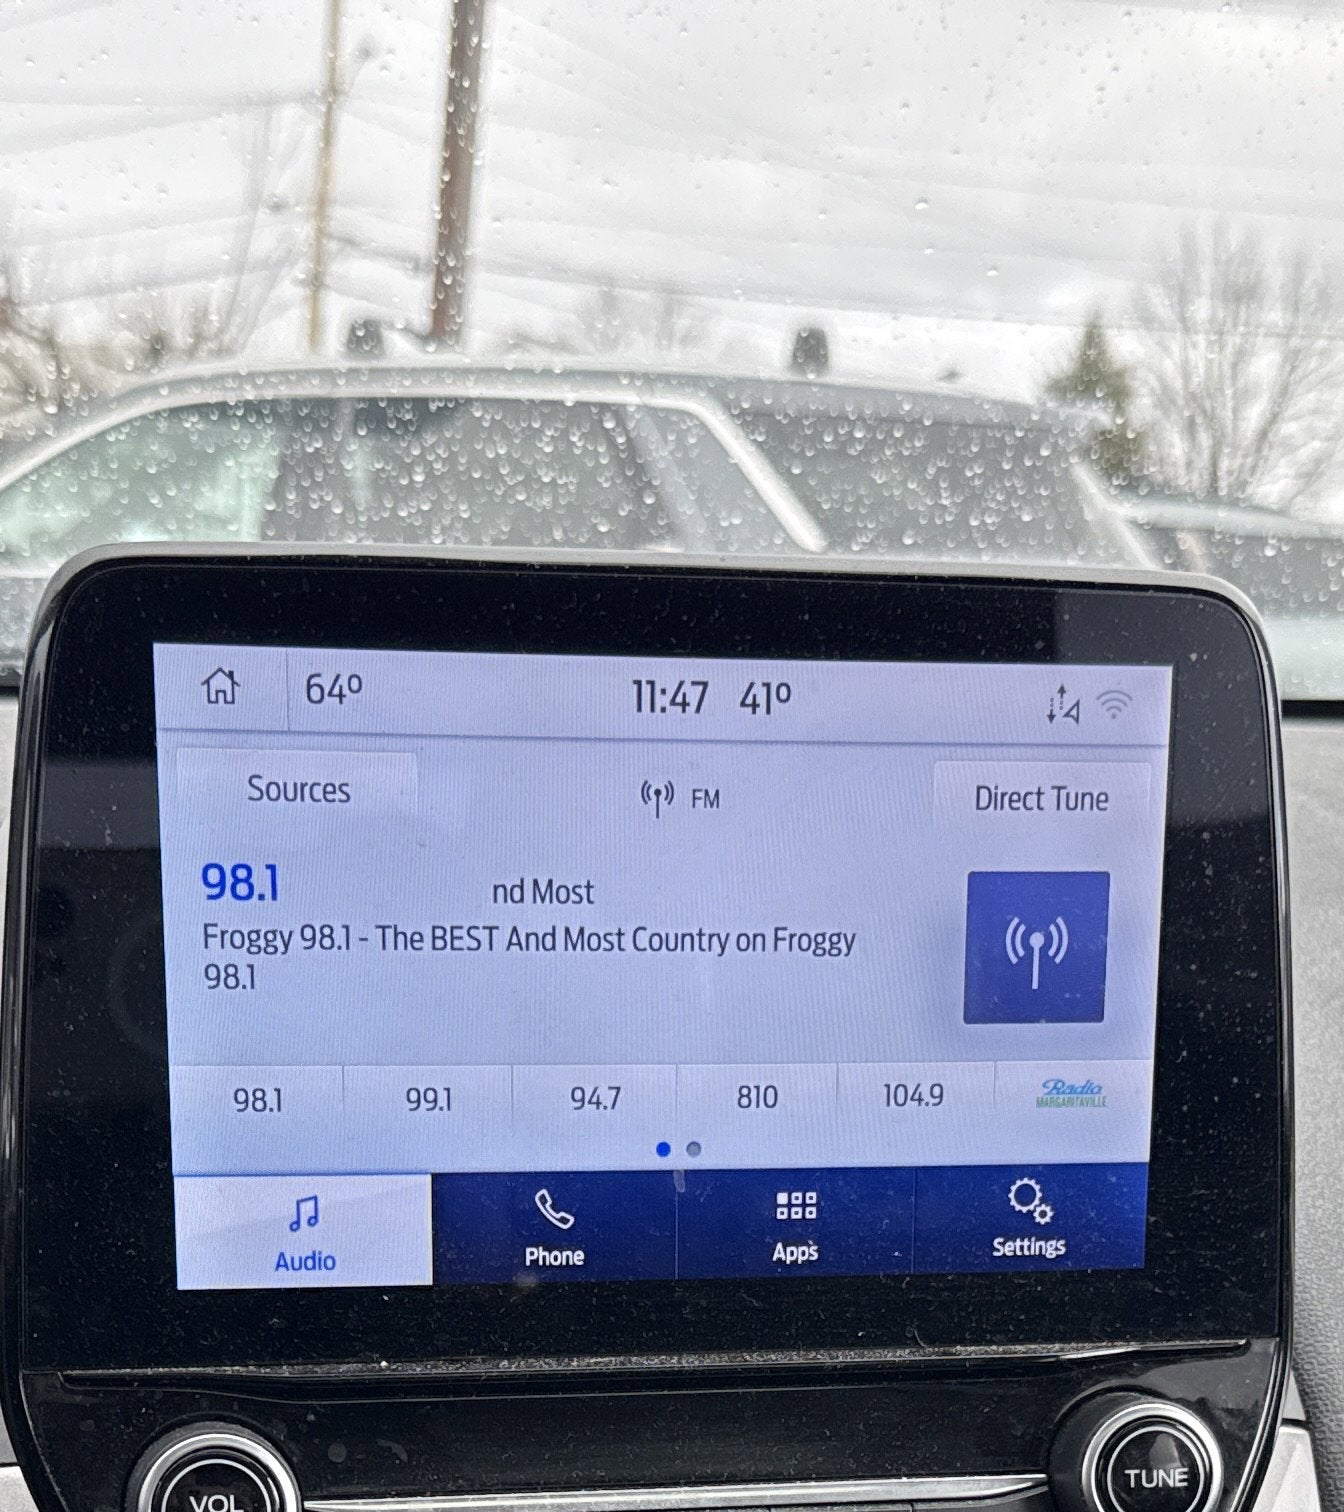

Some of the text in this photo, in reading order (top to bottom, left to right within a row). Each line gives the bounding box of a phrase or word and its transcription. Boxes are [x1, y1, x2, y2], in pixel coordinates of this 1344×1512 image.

[632, 679, 709, 713] 11:47
[247, 774, 351, 803] Sources
[692, 788, 720, 809] FM
[975, 784, 1109, 811] Direct Tune
[201, 863, 278, 901] 98.1
[492, 877, 595, 905] nd Most
[203, 922, 293, 955] Froggy
[300, 923, 350, 951] 98.1
[375, 924, 424, 951] The
[431, 925, 499, 951] BEST
[506, 925, 557, 952] And
[563, 926, 626, 952] Most
[632, 926, 730, 957] Country
[735, 931, 766, 952] on
[773, 926, 857, 957] Froggy
[204, 962, 256, 990] 98.1
[233, 1087, 282, 1113] 98.1
[405, 1086, 452, 1112] 99.1
[570, 1085, 622, 1111] 94.7
[737, 1084, 779, 1109] 810
[883, 1082, 944, 1108] 104.9
[525, 1245, 585, 1267] Phone
[772, 1241, 818, 1264] Apps
[992, 1235, 1066, 1259] Settings
[274, 1250, 336, 1272] Audio
[1124, 1467, 1189, 1488] TUNE
